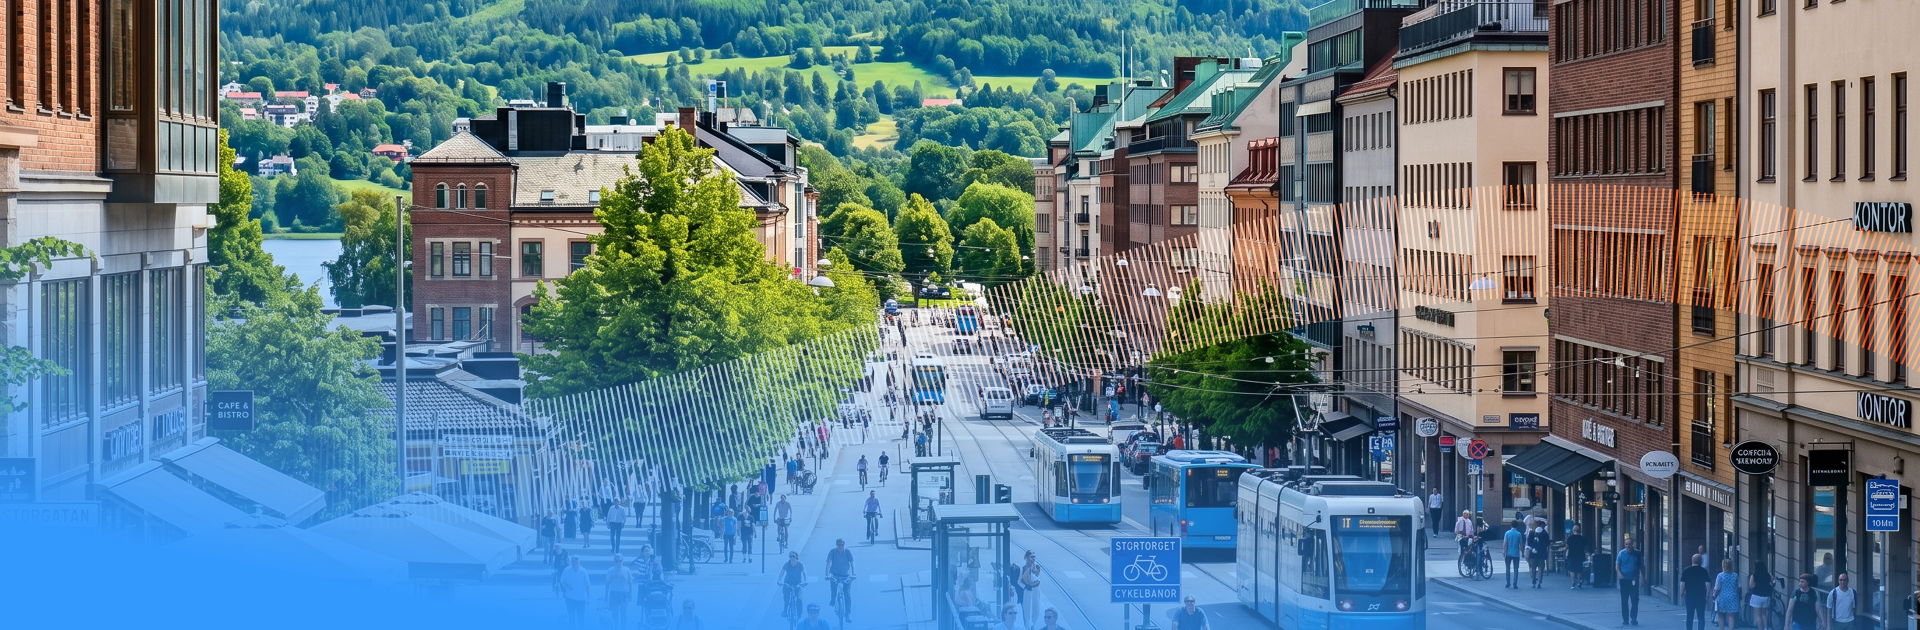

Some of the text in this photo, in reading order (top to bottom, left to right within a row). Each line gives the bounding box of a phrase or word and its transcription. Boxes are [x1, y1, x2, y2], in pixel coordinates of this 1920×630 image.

[1854, 202, 1906, 232] KONTOR
[218, 411, 249, 419] BISTRO
[1858, 392, 1905, 428] KONTOR
[1115, 541, 1176, 551] STORTORGET
[1114, 589, 1177, 598] CYKELBANOR
